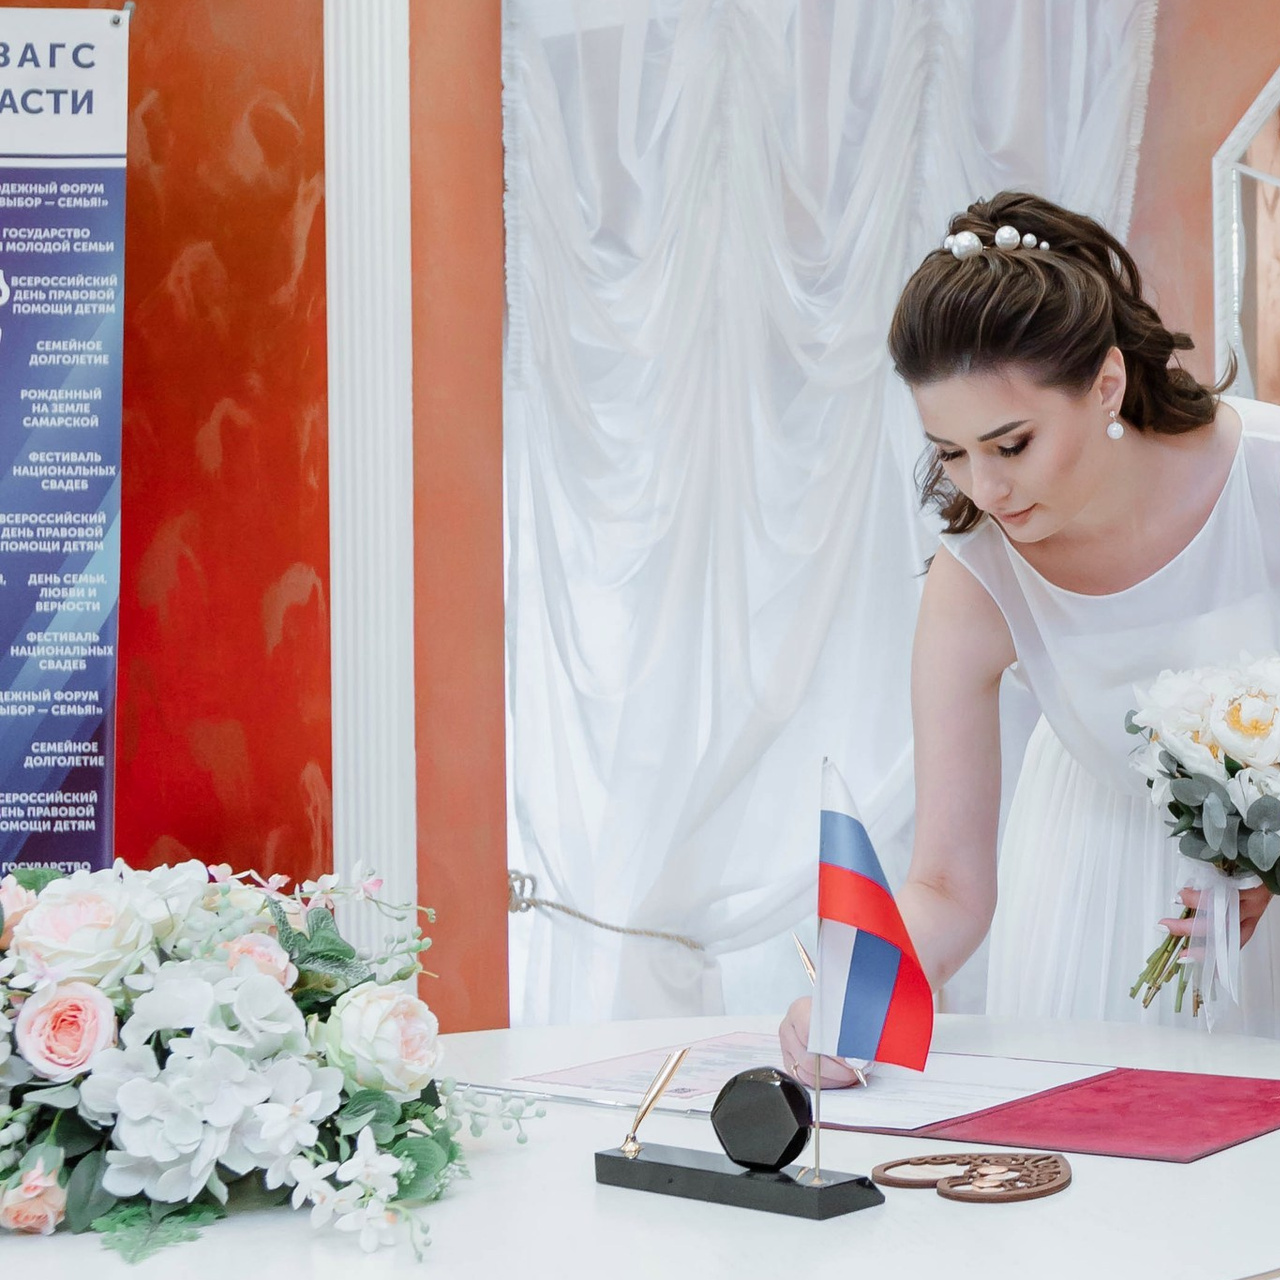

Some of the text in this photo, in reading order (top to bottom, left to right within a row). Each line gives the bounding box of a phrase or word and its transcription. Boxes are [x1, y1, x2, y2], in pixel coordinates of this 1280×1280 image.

[0, 88, 93, 114] АСТИ
[0, 181, 104, 195] ДЕЖНЫЙ ФОРУМ
[57, 197, 109, 208] СЕМЬЯ!»
[2, 228, 91, 239] ГОСУДАРСТВО
[6, 240, 70, 253] МОЛОДОЙ
[73, 242, 115, 252] СЕМЬИ
[11, 274, 118, 287] ВСЕРОССИЙСКИЙ
[13, 288, 115, 301] ДЕНЬ ПРАВОВОЙ
[12, 303, 116, 315] ПОМОЩИ ДЕТЯМ
[36, 339, 103, 351] СЕМЕЙНОЕ
[29, 354, 110, 366] ДОЛГОЛЕТИЕ
[20, 387, 102, 401] РОЖДЕННЫЙ
[32, 403, 91, 413] НА ЗЕМЛЕ
[22, 415, 99, 427] САМАРСКОЙ
[28, 452, 102, 462] ФЕСТИВАЛЬ
[12, 466, 116, 477] НАЦИОНАЛЬНЫХ
[41, 480, 89, 492] СВАДЕБ
[0, 512, 107, 524] ВСЕРОССИЙСКИЙ
[1, 525, 103, 539] ДЕНЬ ПРАВОВОЙ
[0, 541, 104, 553] ПОМОЩИ ДЕТЯМ
[28, 574, 107, 585] ДЕНЬ СЕМЬИ,
[39, 588, 97, 598] ЛЮБВИ И
[35, 601, 100, 612] ВЕРНОСТИ
[26, 632, 100, 642] ФЕСТИВАЛЬ
[10, 646, 114, 657] НАЦИОНАЛЬНЫХ
[39, 660, 87, 671] СВАДЕБ
[53, 691, 99, 701] ФОРУМ
[51, 705, 103, 715] СЕМЬЯ!»
[31, 740, 98, 753] СЕМЕЙНОЕ
[24, 756, 104, 768] ДОЛГОЛЕТИЕ
[0, 805, 95, 818] ЕНЬ ПРАВОВОЙ
[53, 821, 96, 832] ДЕТЯМ
